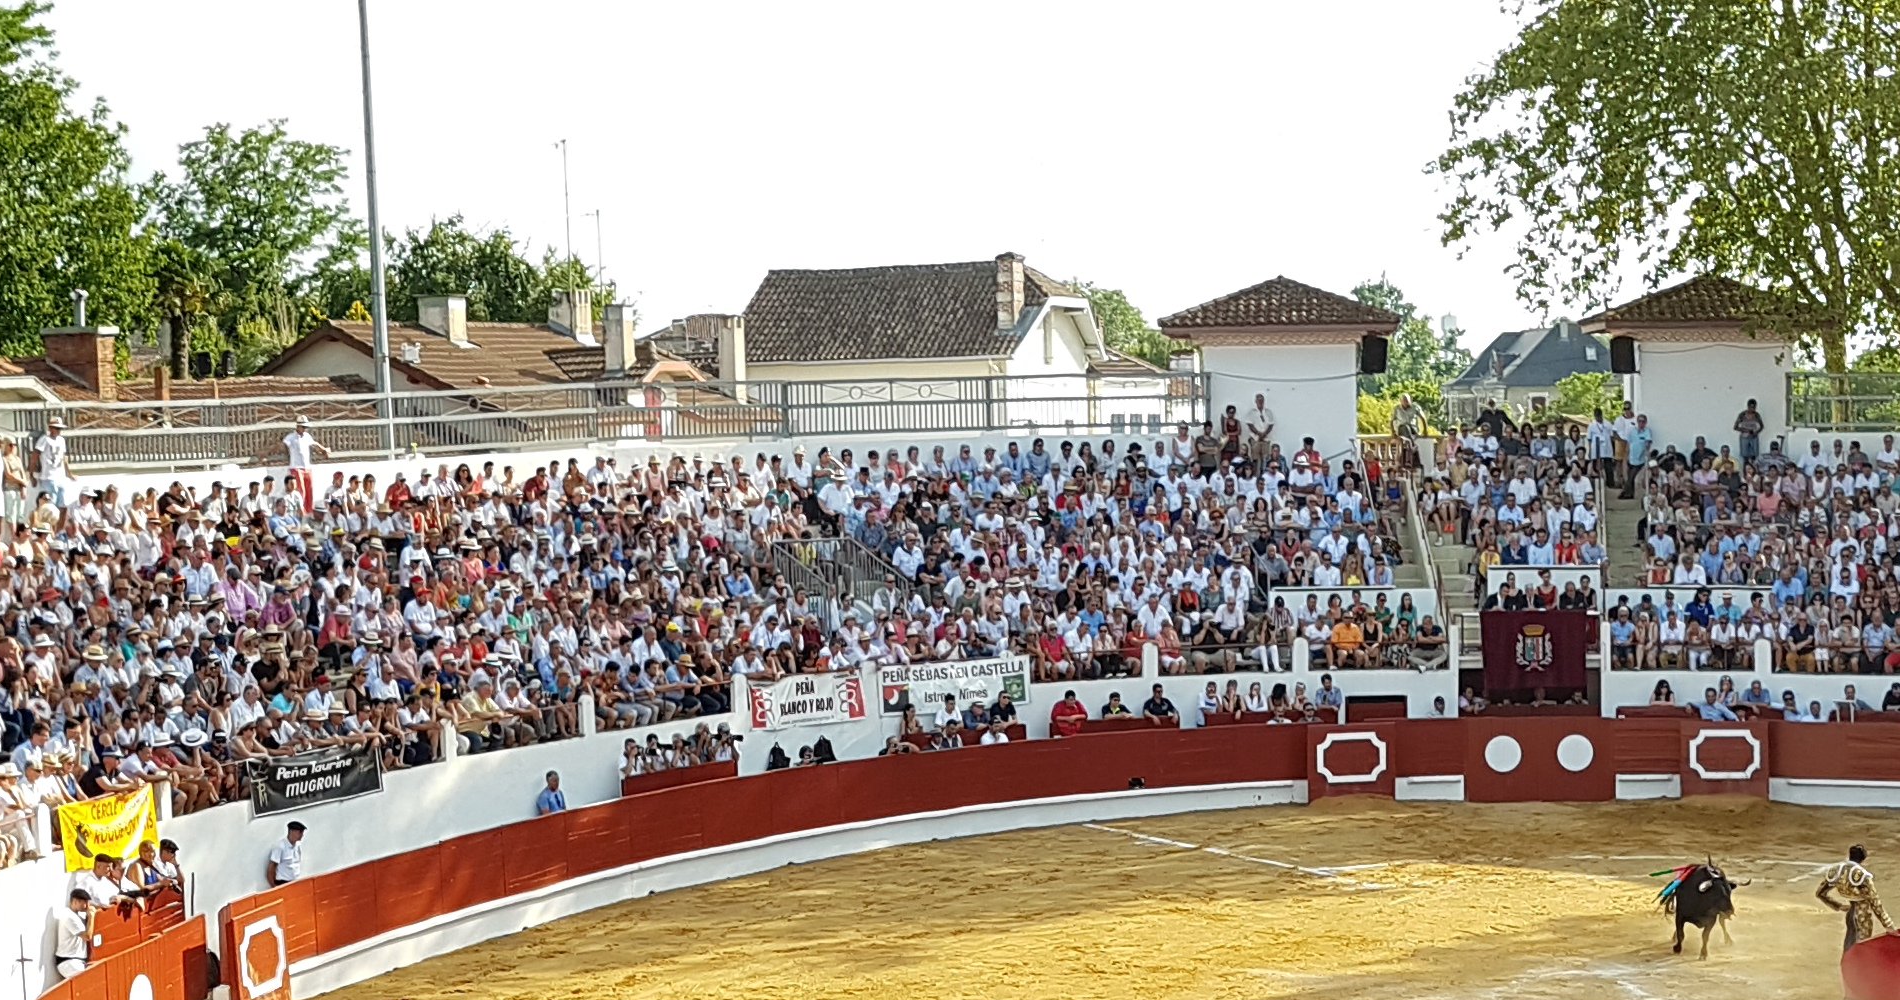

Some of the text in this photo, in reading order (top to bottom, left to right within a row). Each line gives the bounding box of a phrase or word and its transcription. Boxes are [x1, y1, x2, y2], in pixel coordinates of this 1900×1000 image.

[882, 666, 910, 683] PEÑA
[971, 660, 1025, 677] CASTELLA
[795, 677, 815, 696] PEÑA
[924, 690, 946, 703] Istr
[809, 699, 815, 713] Y
[815, 697, 834, 712] ROJO
[276, 756, 353, 781] Peña Taurine
[285, 773, 341, 798] MUGRON
